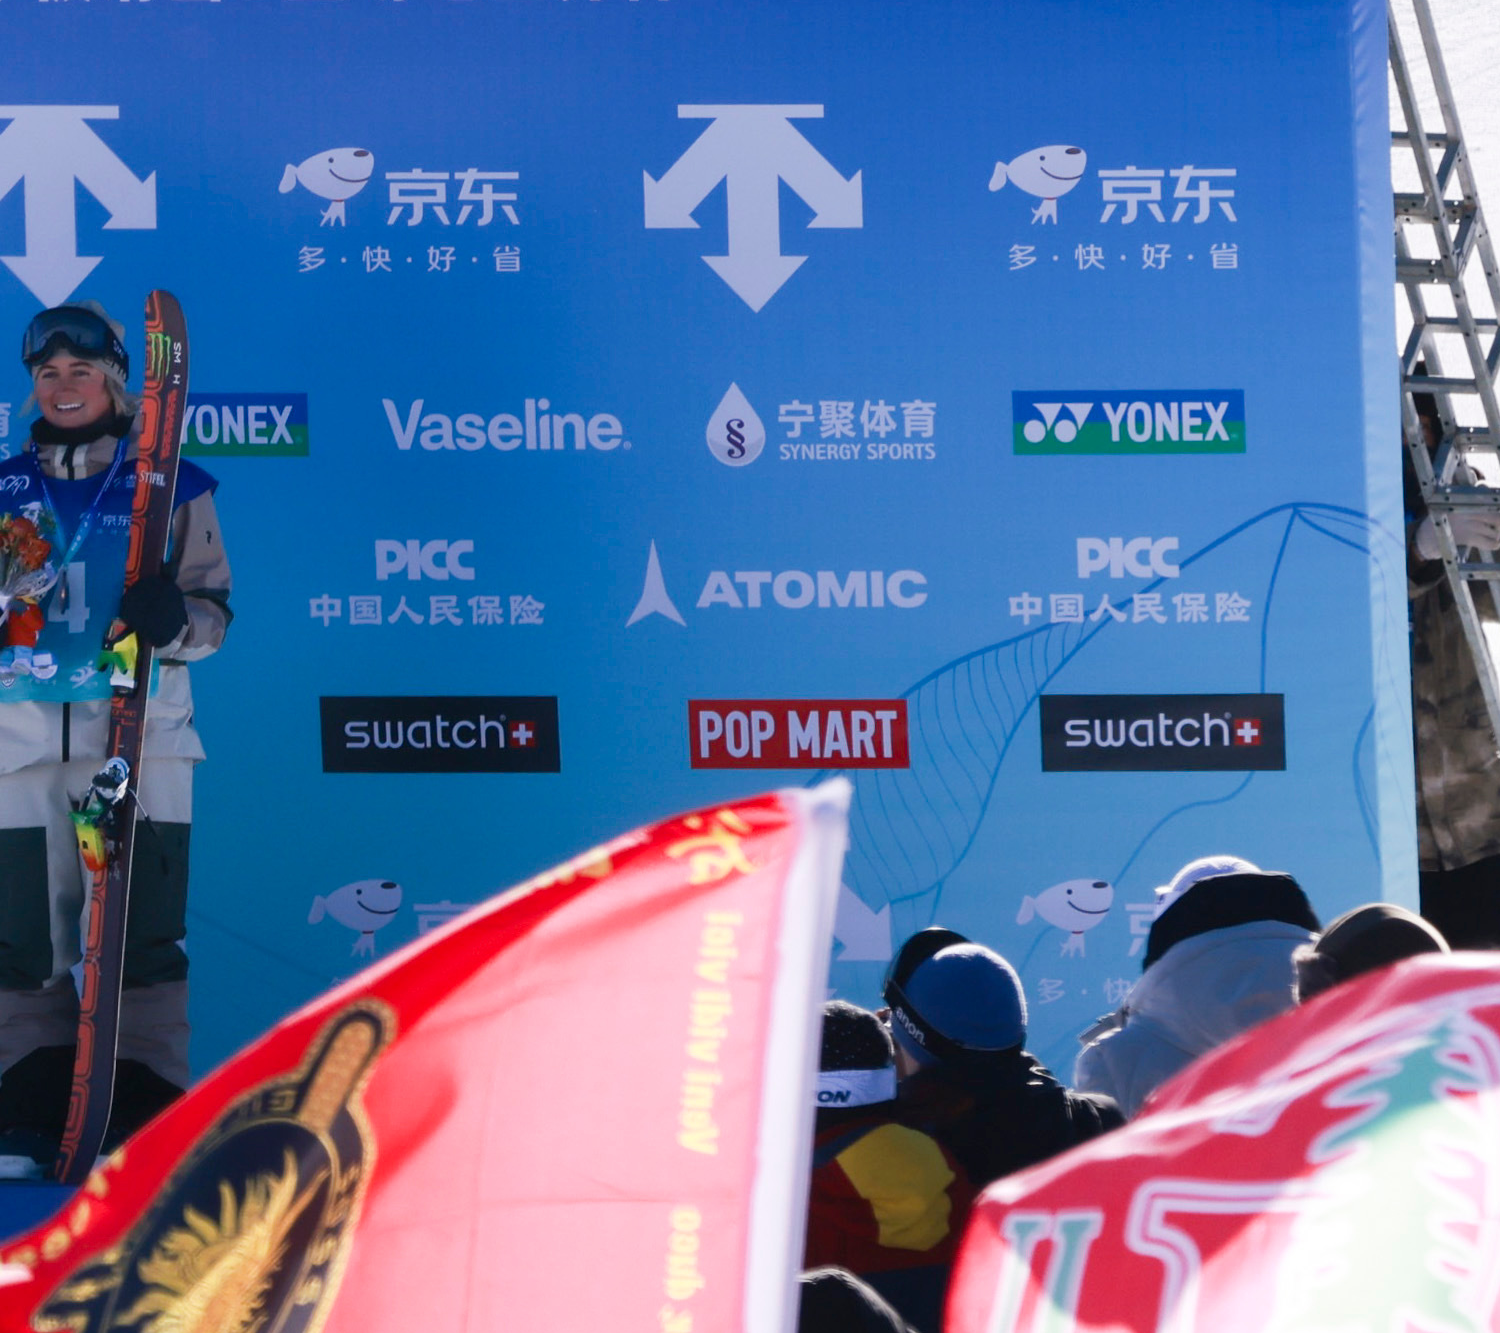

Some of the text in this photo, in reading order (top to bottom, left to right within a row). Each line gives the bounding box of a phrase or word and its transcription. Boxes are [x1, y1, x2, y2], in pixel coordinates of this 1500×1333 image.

[384, 167, 520, 227] 京东
[1097, 164, 1238, 225] 京东
[182, 404, 292, 444] YONEX
[382, 397, 624, 451] Vaseline
[778, 398, 937, 440] 宁聚体育
[1102, 401, 1228, 444] YONEX
[778, 442, 937, 461] SYNERGY SPORTS
[139, 470, 166, 487] STIFEL
[374, 539, 476, 581] PICC
[1076, 536, 1180, 579] PICC
[47, 561, 91, 634] 4
[696, 569, 928, 609] ATOMIC
[1008, 591, 1252, 625] 中国人民保险
[309, 593, 545, 627] 中国人民保险
[344, 711, 504, 750] swatch
[699, 707, 898, 759] POP MART
[1064, 710, 1226, 748] swatch
[817, 1090, 851, 1103] ON
